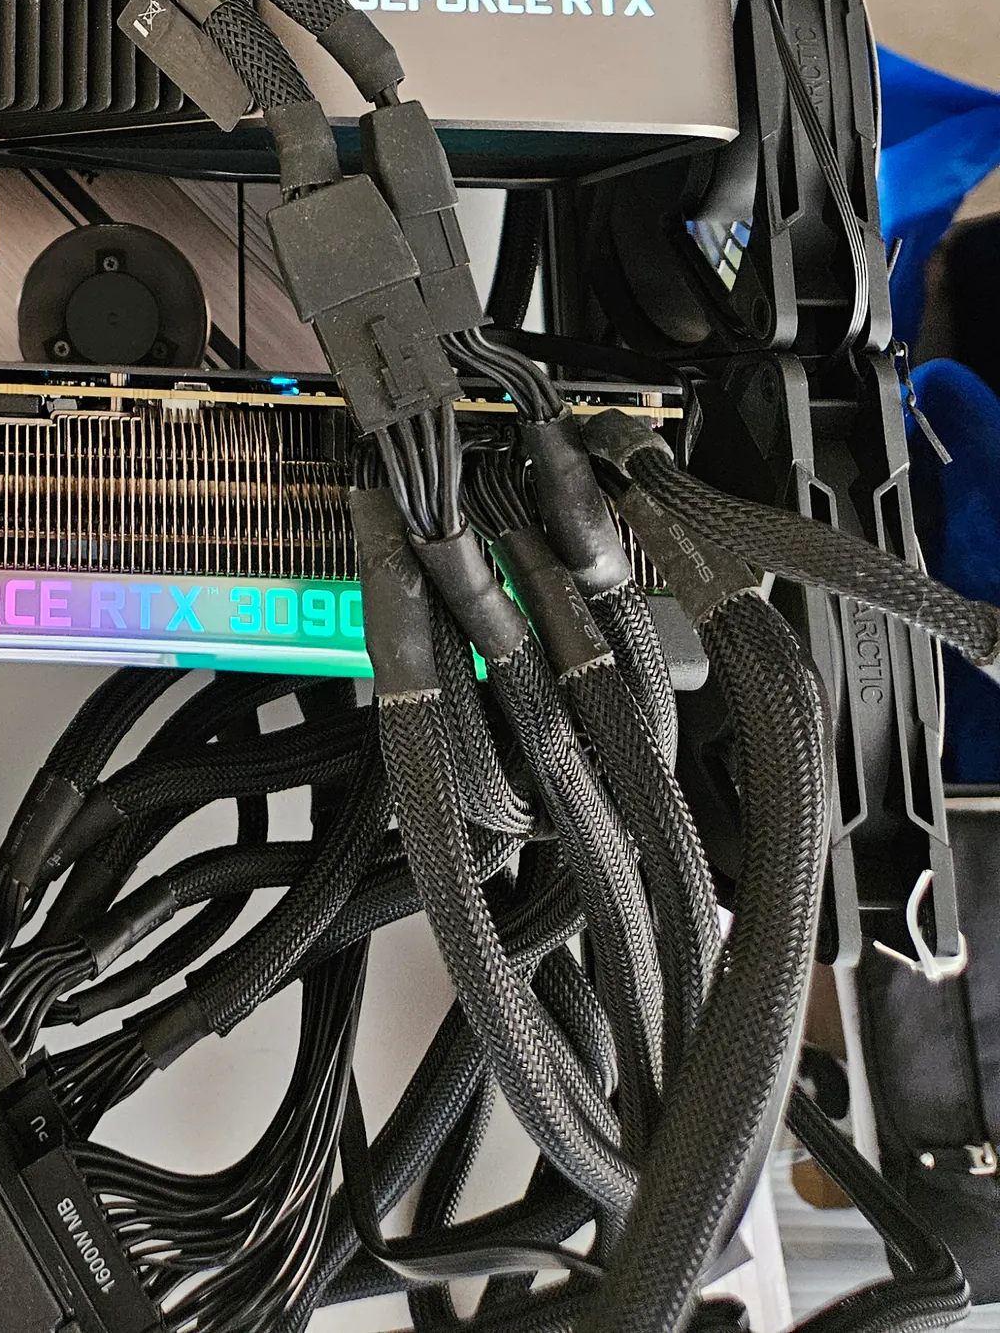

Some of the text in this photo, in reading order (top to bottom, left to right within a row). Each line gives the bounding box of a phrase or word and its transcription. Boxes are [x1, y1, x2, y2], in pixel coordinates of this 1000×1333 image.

[230, 586, 363, 638] 3090
[57, 1197, 115, 1294] 1600W MB
